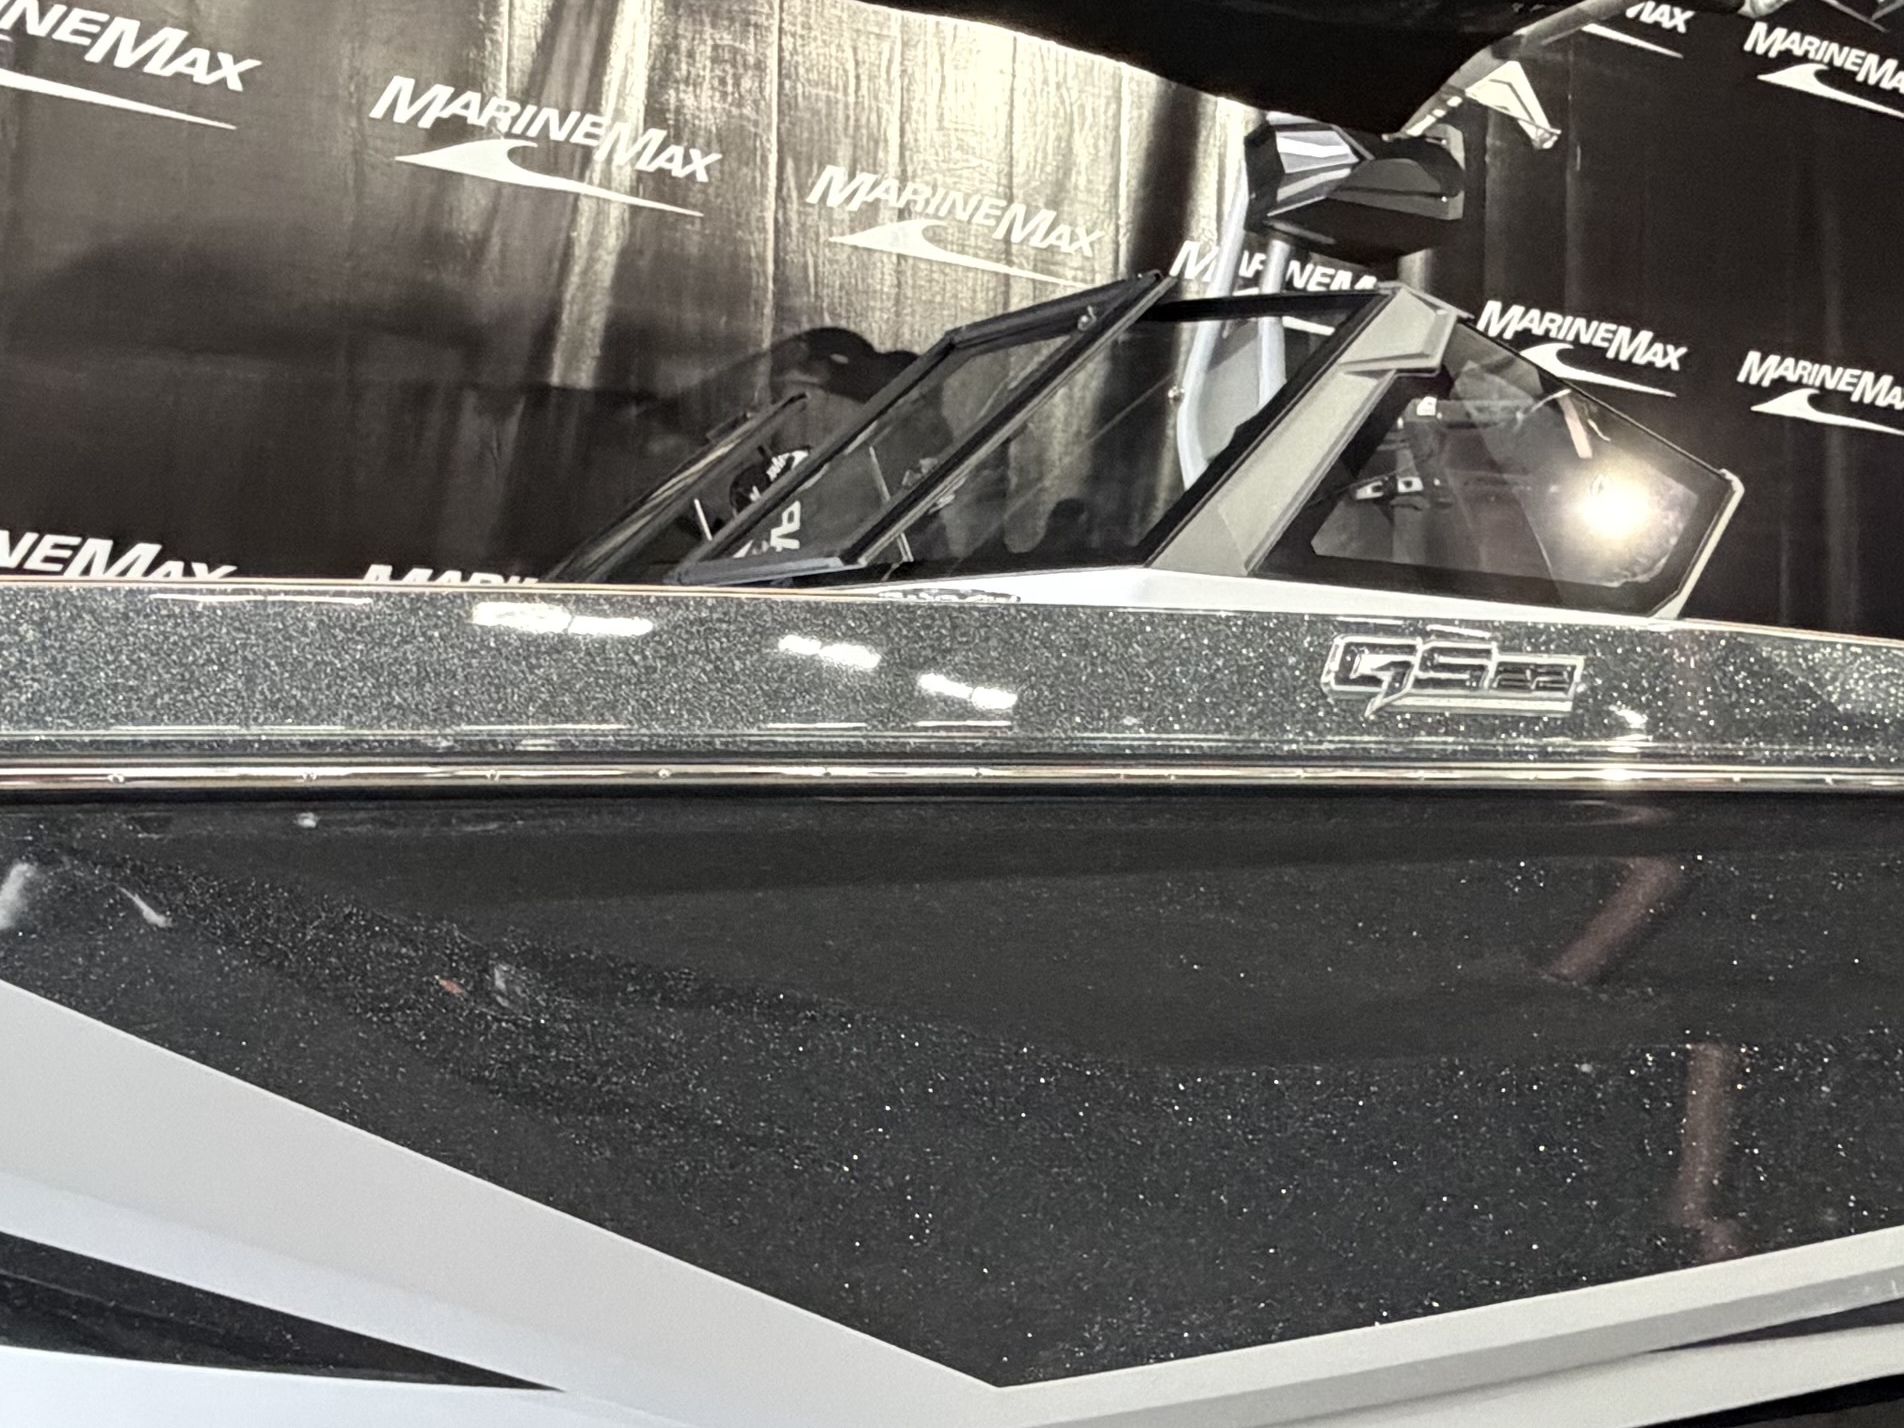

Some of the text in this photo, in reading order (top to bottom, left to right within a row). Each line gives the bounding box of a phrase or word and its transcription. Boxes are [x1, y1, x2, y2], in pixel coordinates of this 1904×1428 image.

[369, 76, 722, 183] MARINEMAX
[806, 165, 1104, 257] MARINEMAX
[1476, 300, 1686, 371] MARINEMAX
